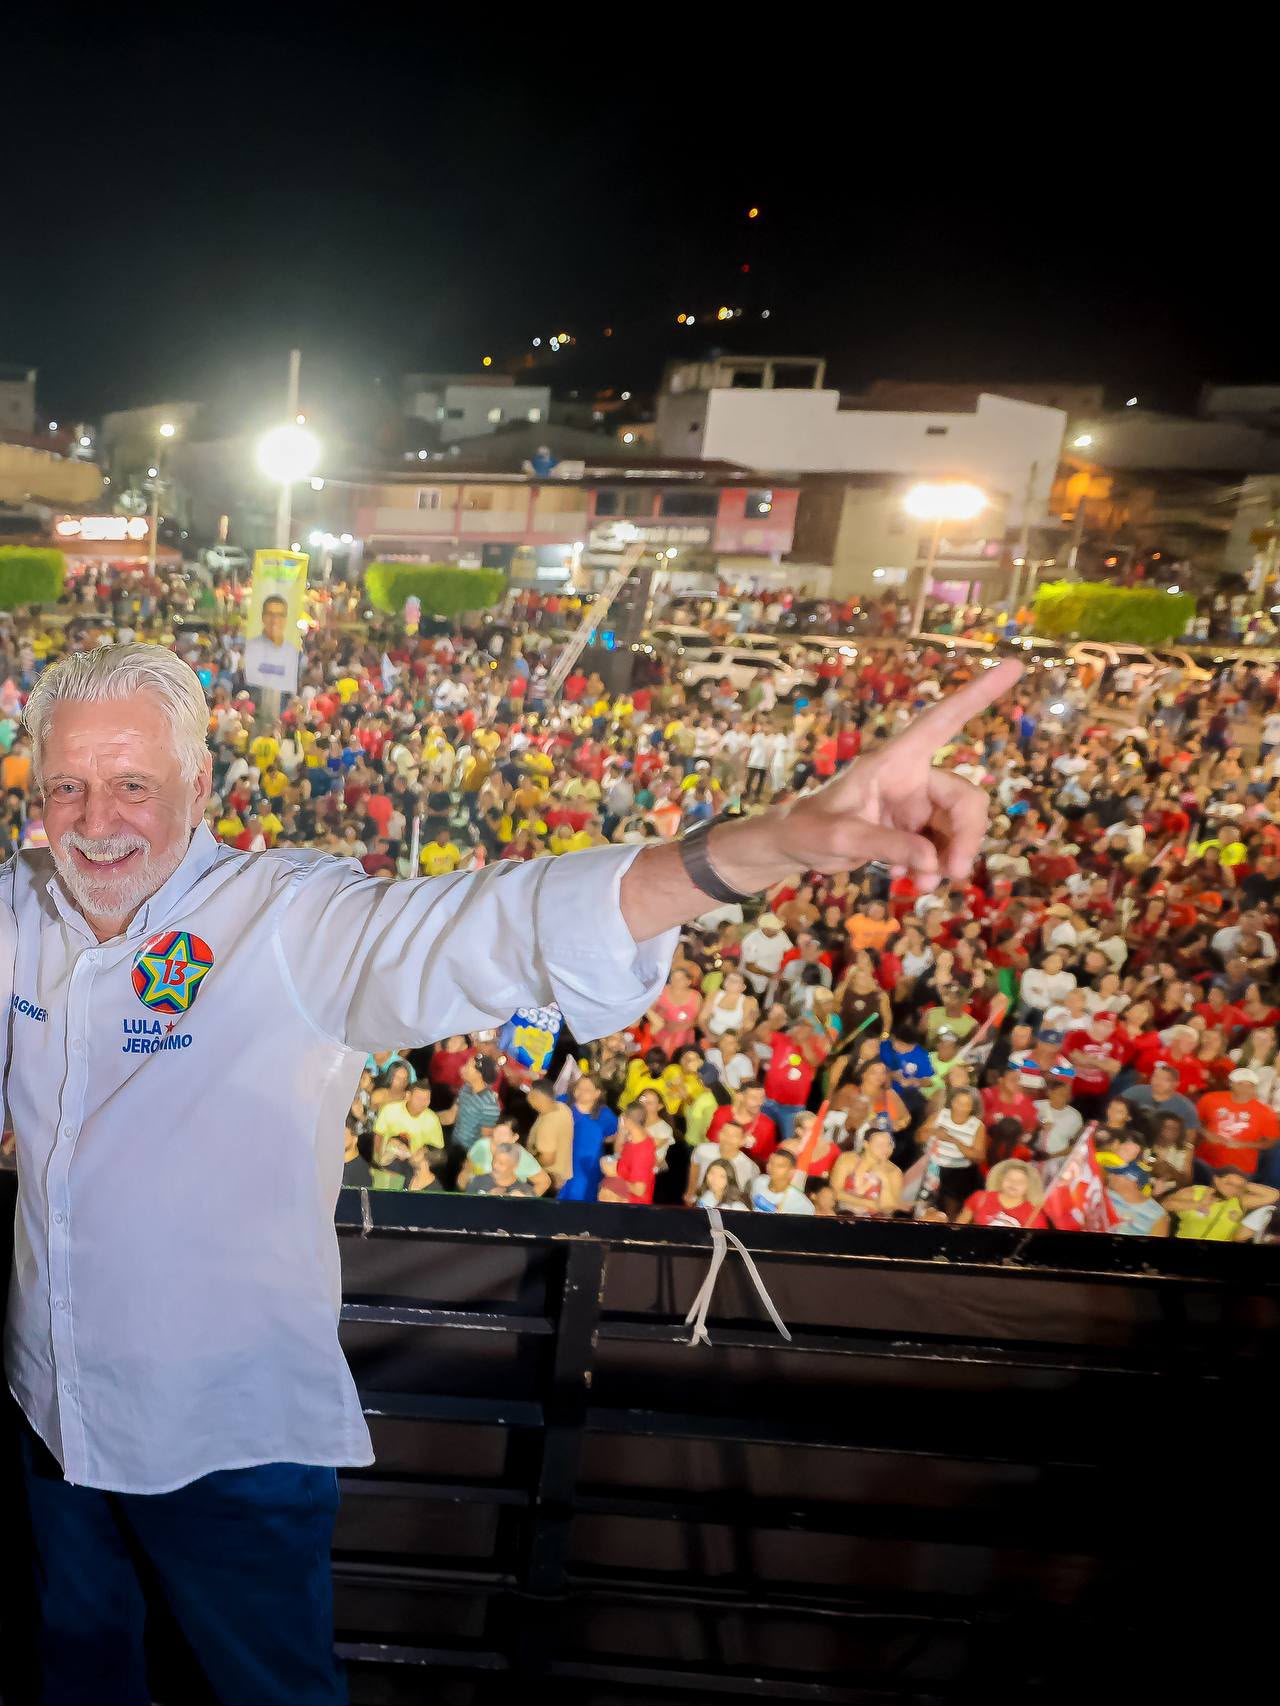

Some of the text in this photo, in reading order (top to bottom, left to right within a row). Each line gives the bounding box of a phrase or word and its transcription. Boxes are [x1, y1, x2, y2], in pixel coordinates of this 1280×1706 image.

[162, 959, 188, 986] 13
[11, 994, 49, 1022] AGNER
[123, 1019, 162, 1035] LULA
